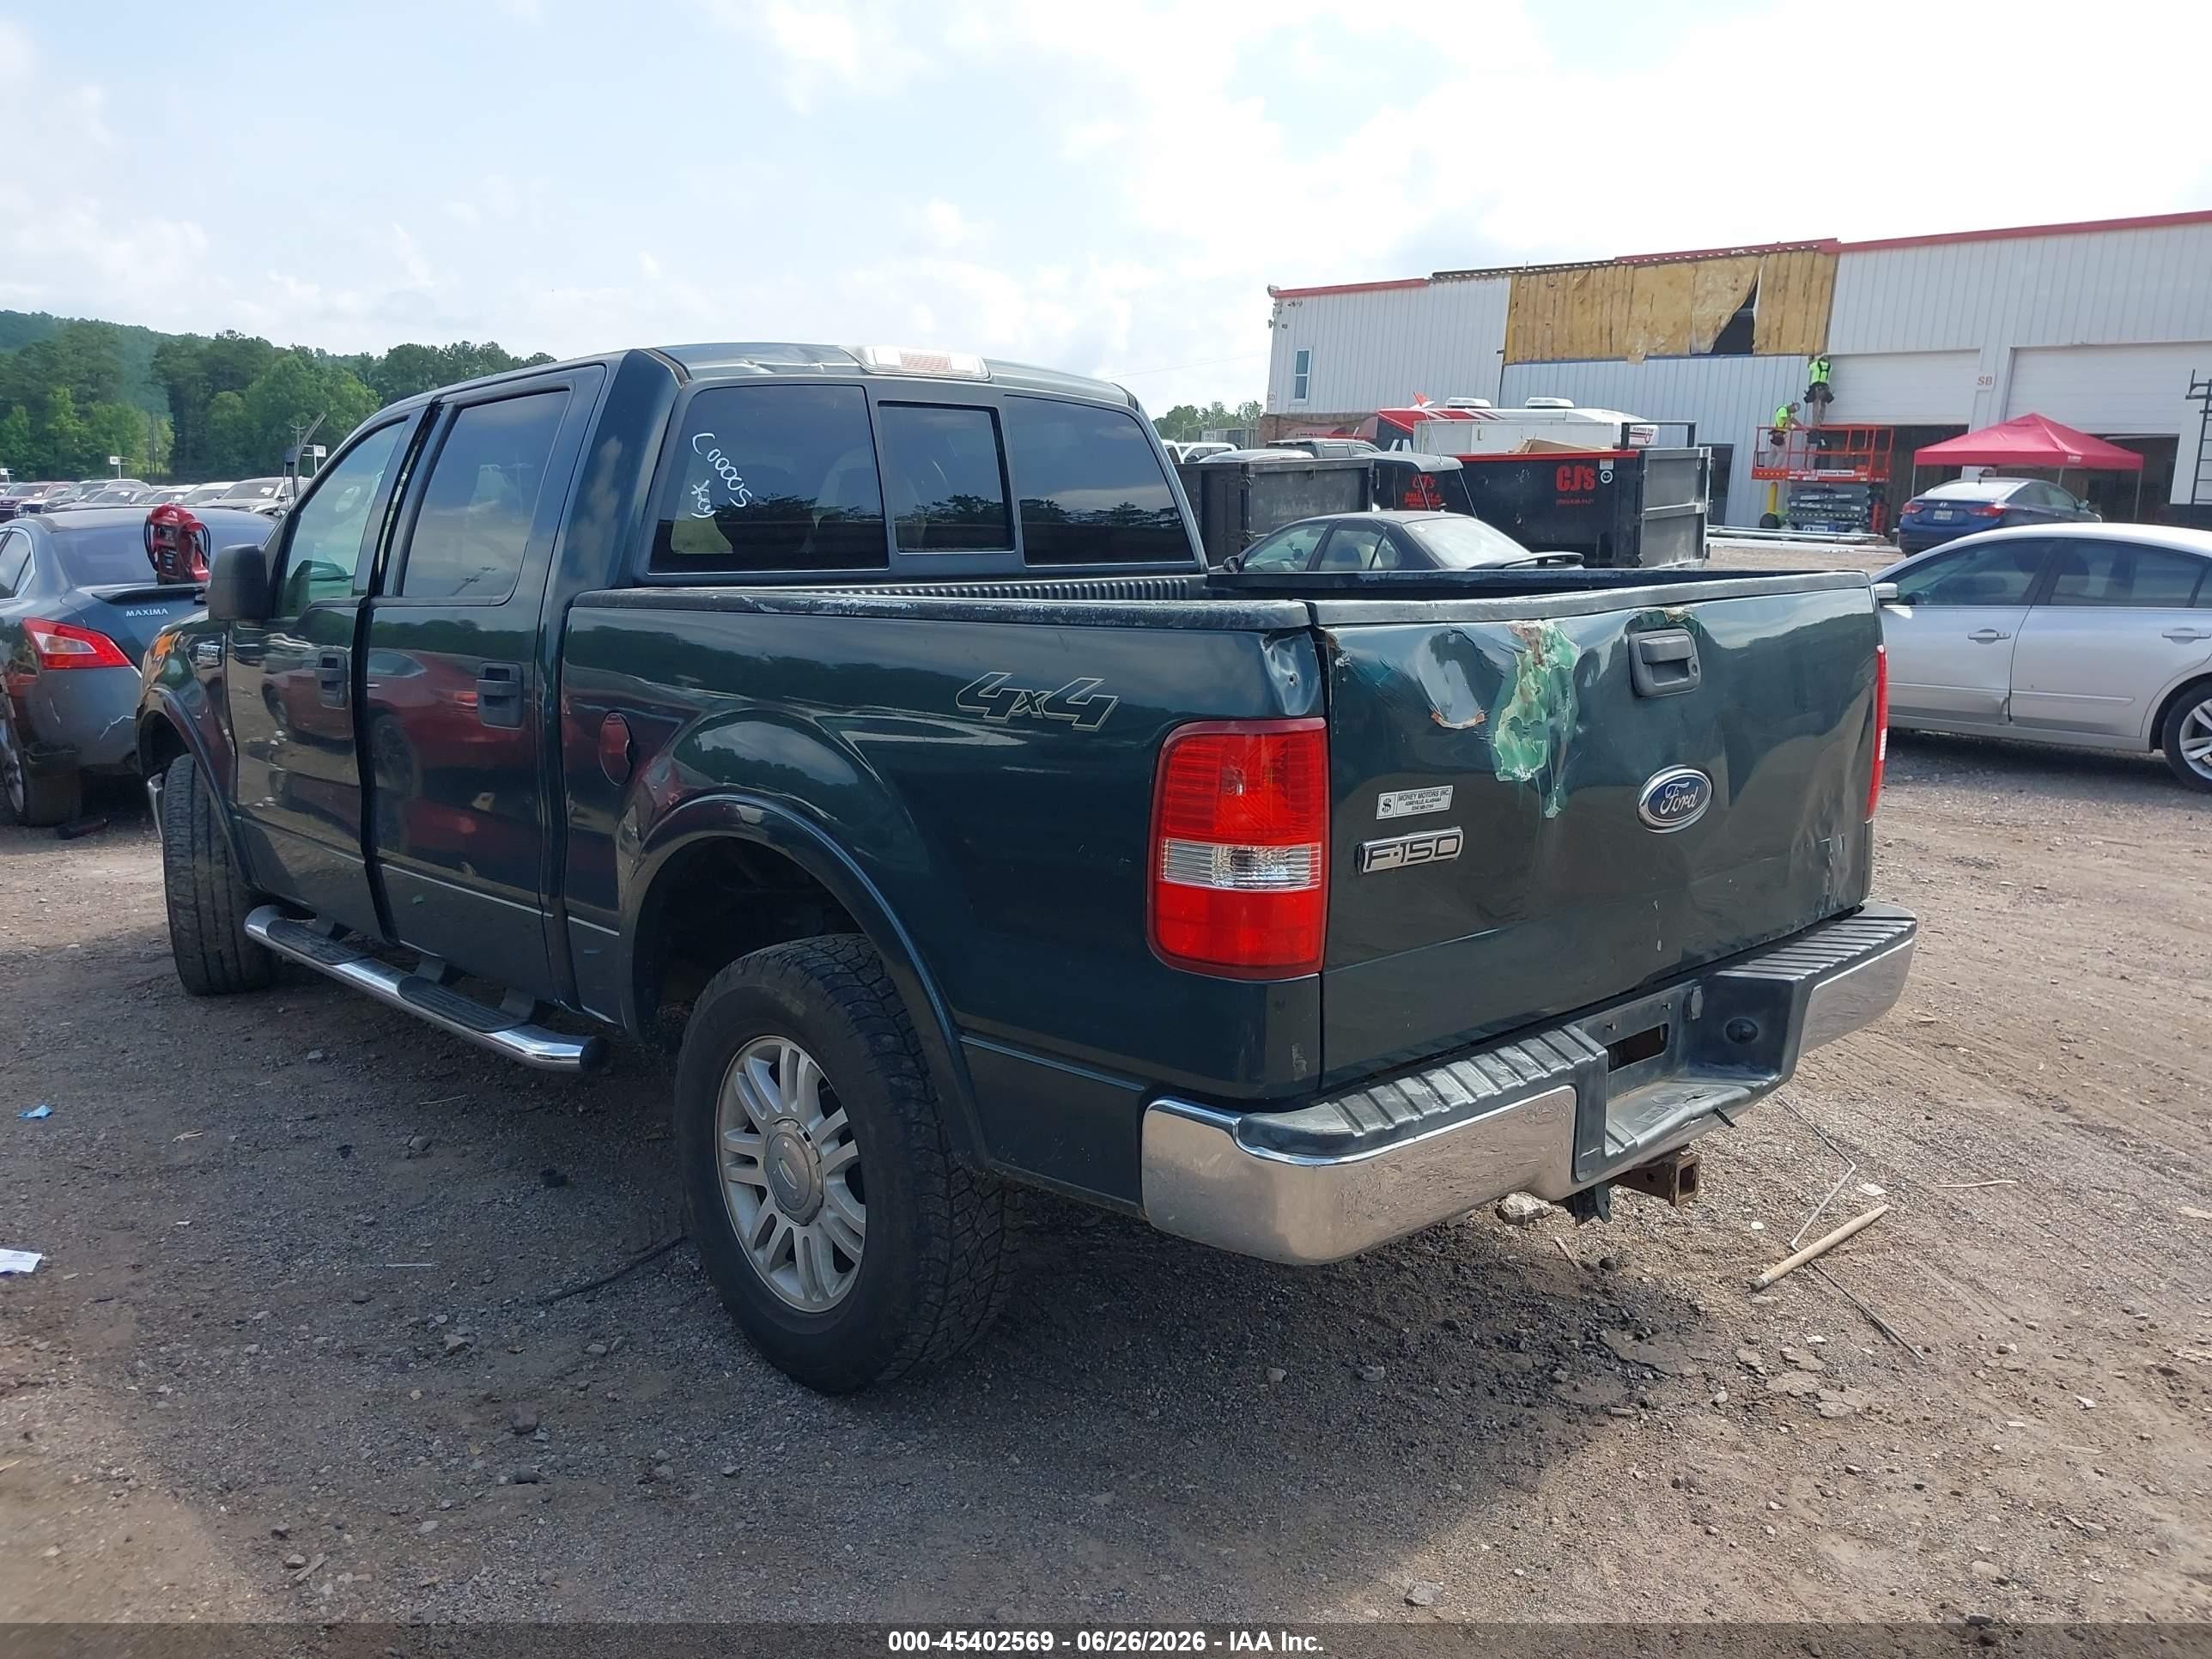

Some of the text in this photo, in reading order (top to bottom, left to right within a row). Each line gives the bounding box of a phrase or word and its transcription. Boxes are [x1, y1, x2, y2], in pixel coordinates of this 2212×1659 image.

[125, 608, 169, 617] MAXIMA
[1398, 793, 1417, 801] MONEY
[1418, 790, 1439, 799] MOTORS
[1659, 781, 1698, 815] Ford
